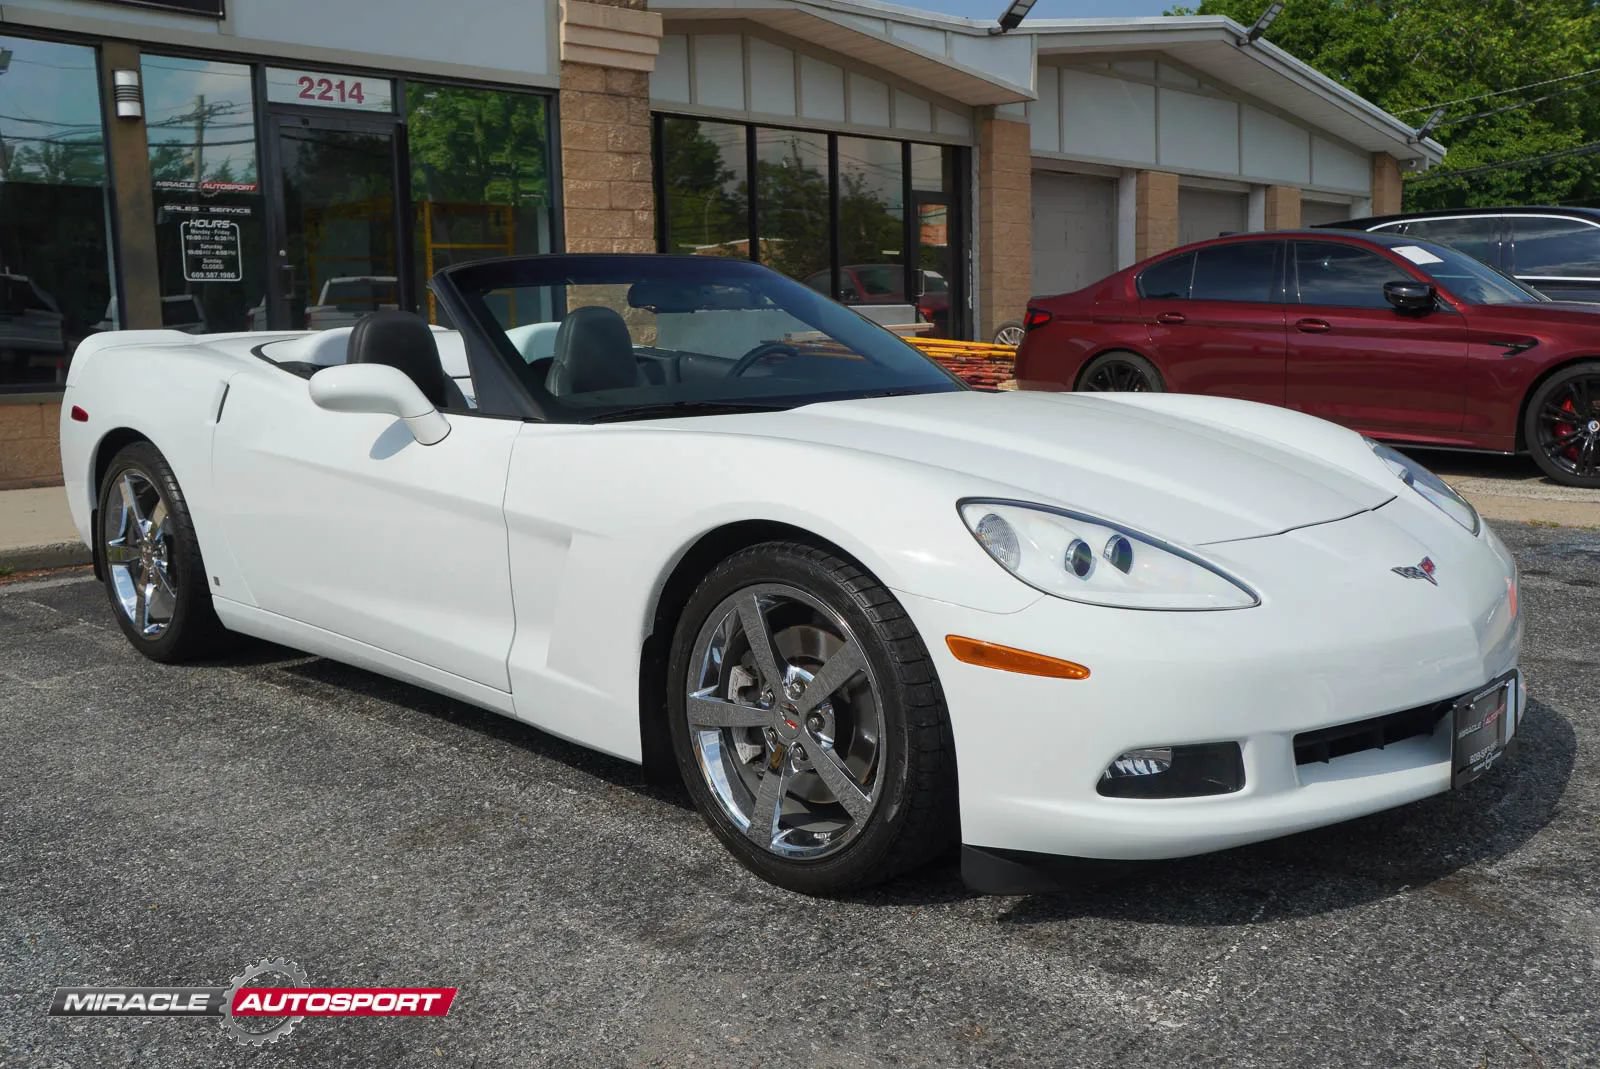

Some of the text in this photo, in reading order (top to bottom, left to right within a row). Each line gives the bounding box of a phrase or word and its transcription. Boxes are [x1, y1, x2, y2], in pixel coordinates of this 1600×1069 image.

[298, 76, 365, 104] 2214
[156, 181, 256, 191] MIRACLE AUTOSPORT
[209, 206, 252, 214] SERVICE
[189, 219, 231, 229] HOURS
[190, 271, 236, 279] 609.587.1986
